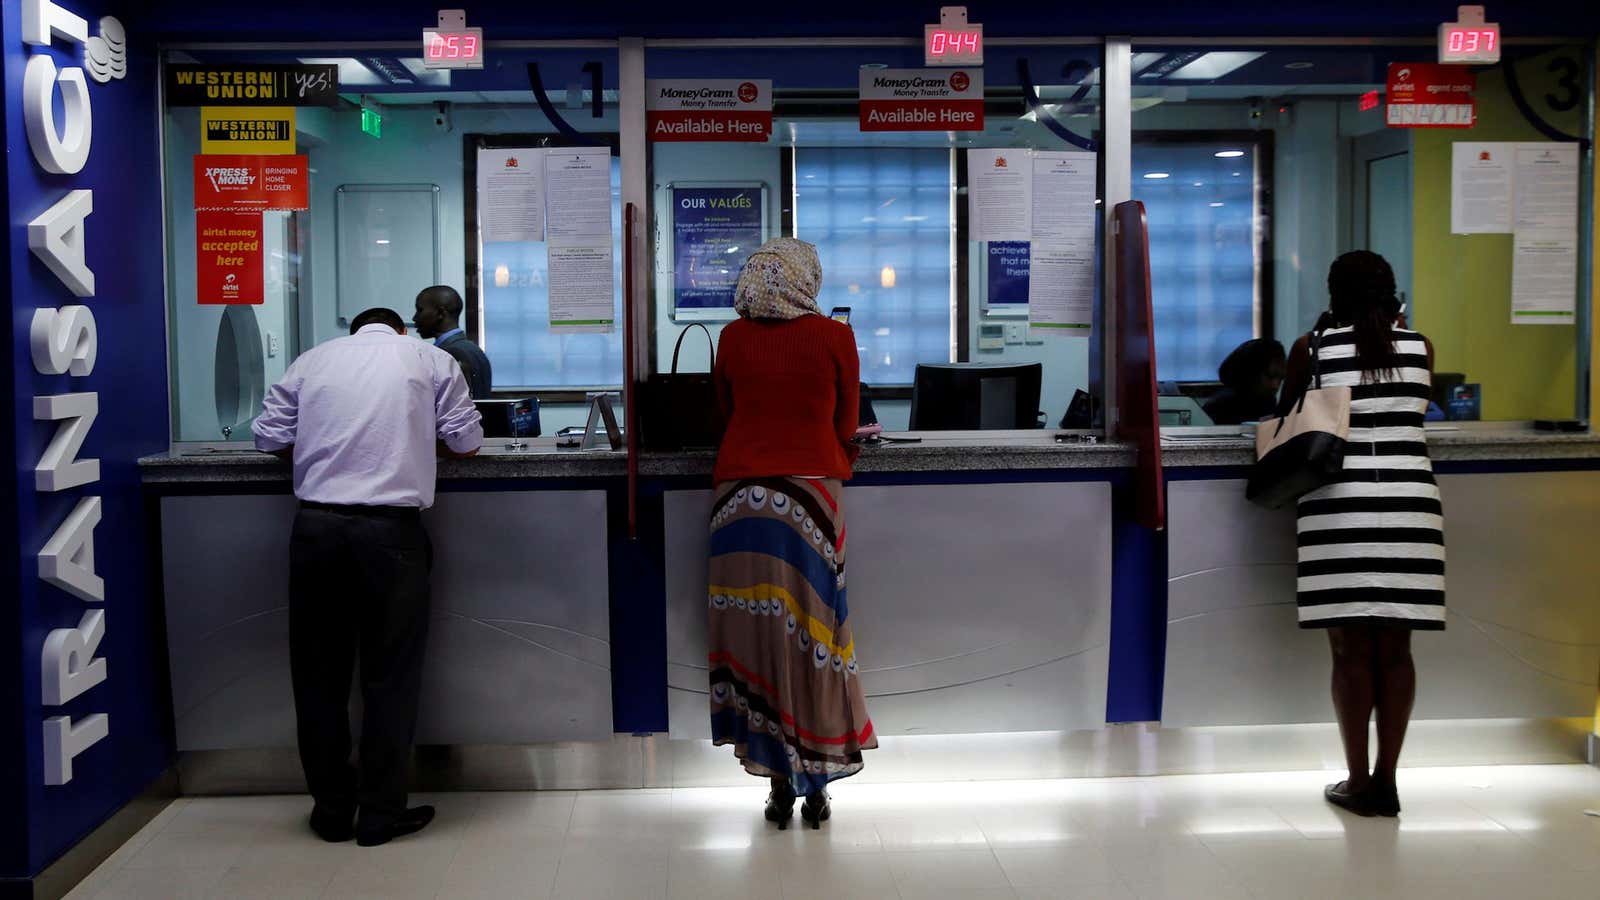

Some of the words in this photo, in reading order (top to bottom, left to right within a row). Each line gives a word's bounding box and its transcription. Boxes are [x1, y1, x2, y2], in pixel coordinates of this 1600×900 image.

[429, 36, 477, 58] 053
[931, 32, 978, 54] 044
[1449, 31, 1495, 52] 037
[176, 71, 273, 85] WESTERN
[294, 68, 332, 98] yes!
[873, 77, 946, 90] MoneyGram
[1545, 57, 1581, 112] 3
[207, 85, 273, 98] UNION
[581, 62, 603, 118] 1
[660, 87, 734, 99] MoneyGram
[893, 88, 919, 98] Money
[920, 88, 950, 97] Transfer
[680, 99, 706, 109] Money
[708, 99, 737, 107] Transfer
[868, 107, 936, 123] Available
[940, 108, 976, 123] Here
[208, 121, 276, 131] WESTERN
[655, 119, 724, 133] Available
[727, 119, 763, 133] Here
[229, 130, 276, 140] UNION
[265, 167, 298, 175] BRINGING
[217, 175, 256, 185] MONEY
[681, 198, 706, 209] OUR
[709, 198, 752, 209] VALUES
[202, 228, 227, 237] airtel
[228, 229, 257, 238] money
[202, 240, 259, 254] accepted
[216, 254, 245, 267] here
